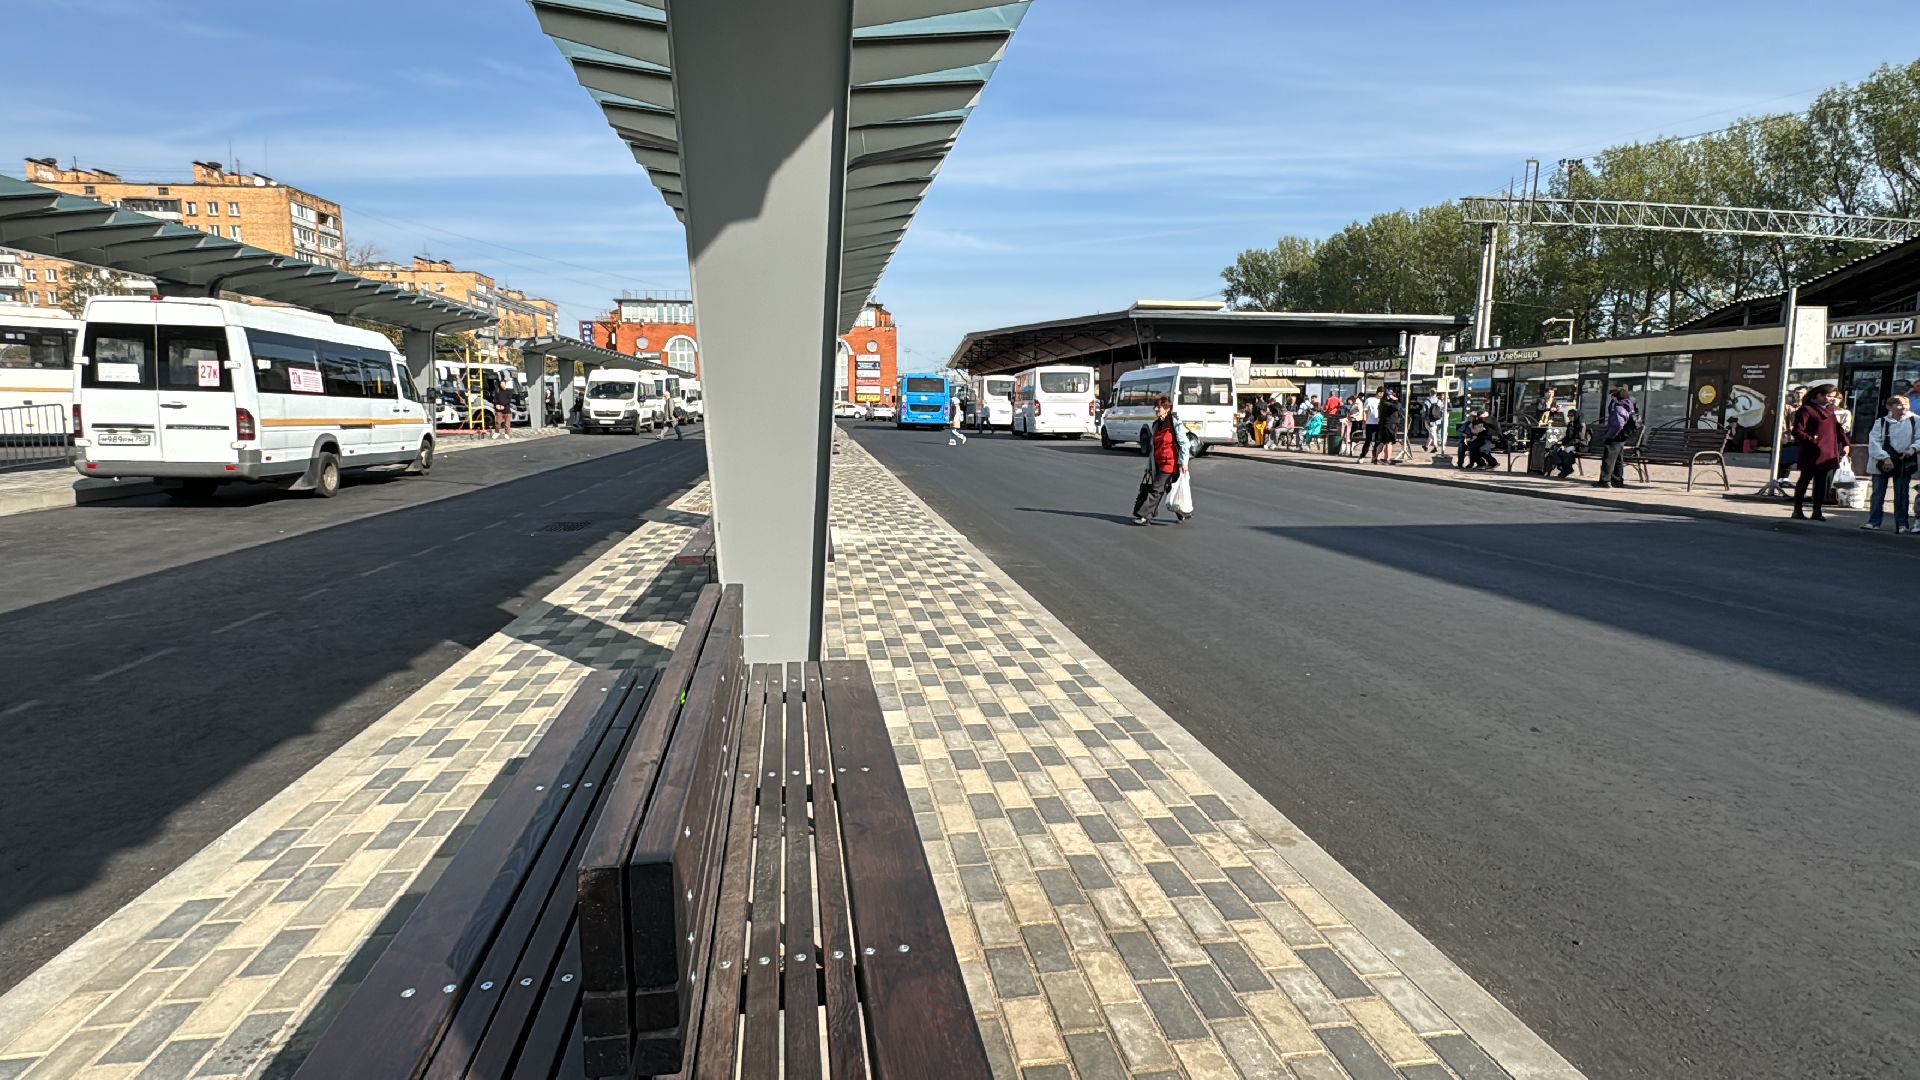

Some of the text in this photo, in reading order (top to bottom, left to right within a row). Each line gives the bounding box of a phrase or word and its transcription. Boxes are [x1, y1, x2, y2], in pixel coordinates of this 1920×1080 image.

[1831, 317, 1914, 338] МЕЛОЧЕЙ
[1455, 354, 1486, 365] Пекарня
[1499, 350, 1539, 361] Хлебница
